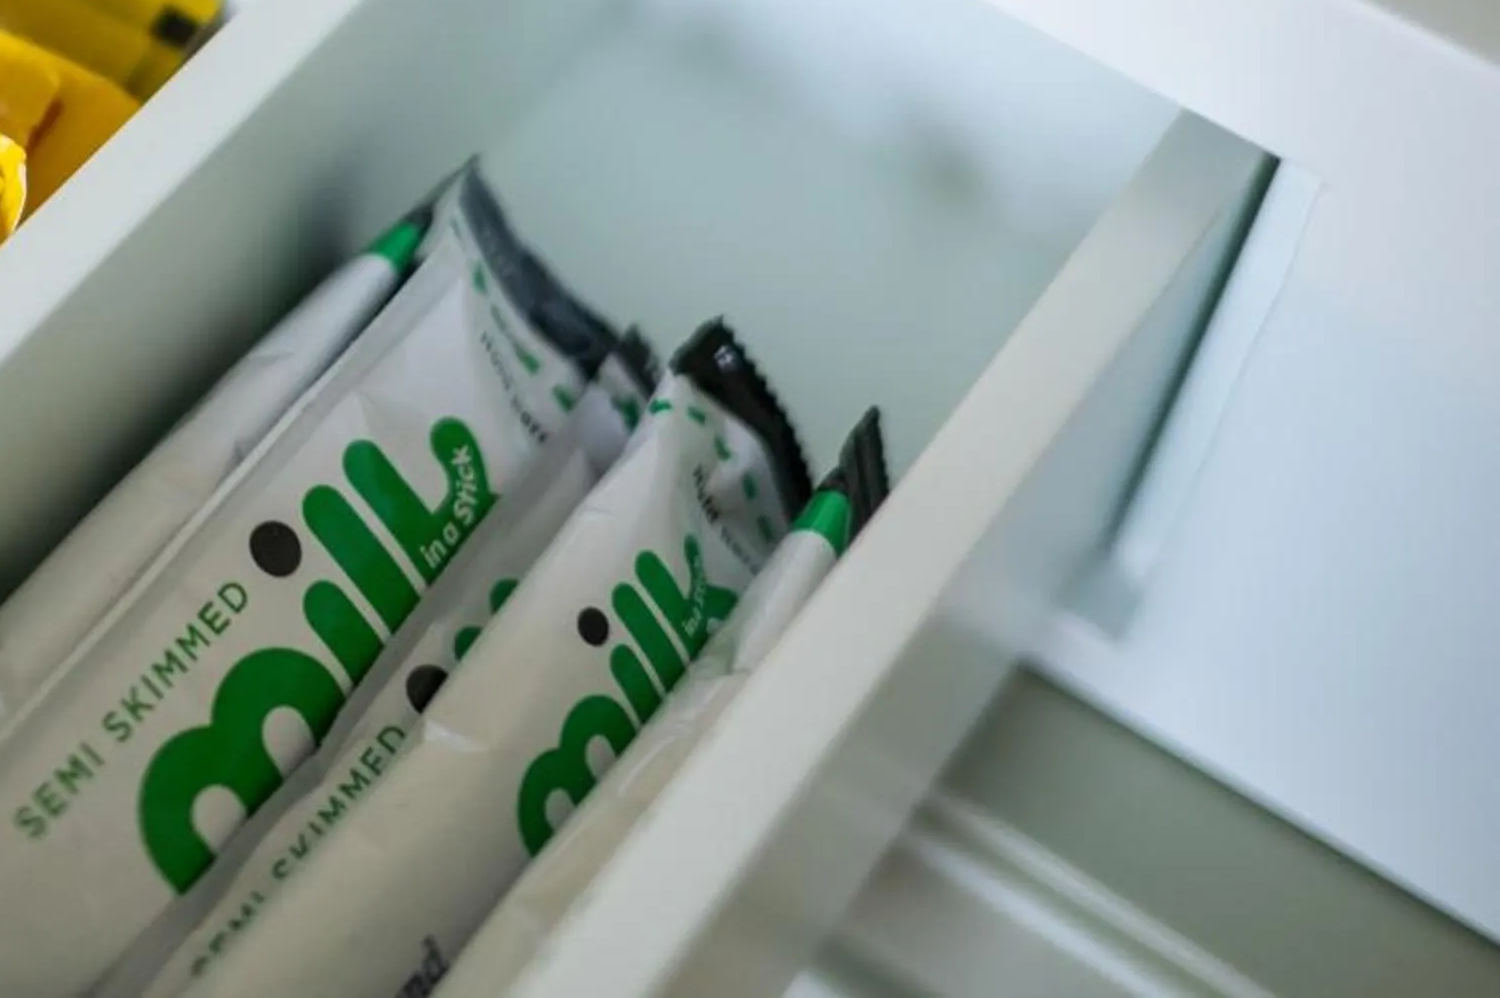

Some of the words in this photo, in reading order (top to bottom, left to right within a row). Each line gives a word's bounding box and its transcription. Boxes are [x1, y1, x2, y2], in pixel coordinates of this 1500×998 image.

[420, 539, 448, 569] in
[443, 521, 460, 547] a
[13, 742, 105, 840] SEMI
[101, 581, 249, 744] SKIMMED
[517, 533, 738, 858] milk
